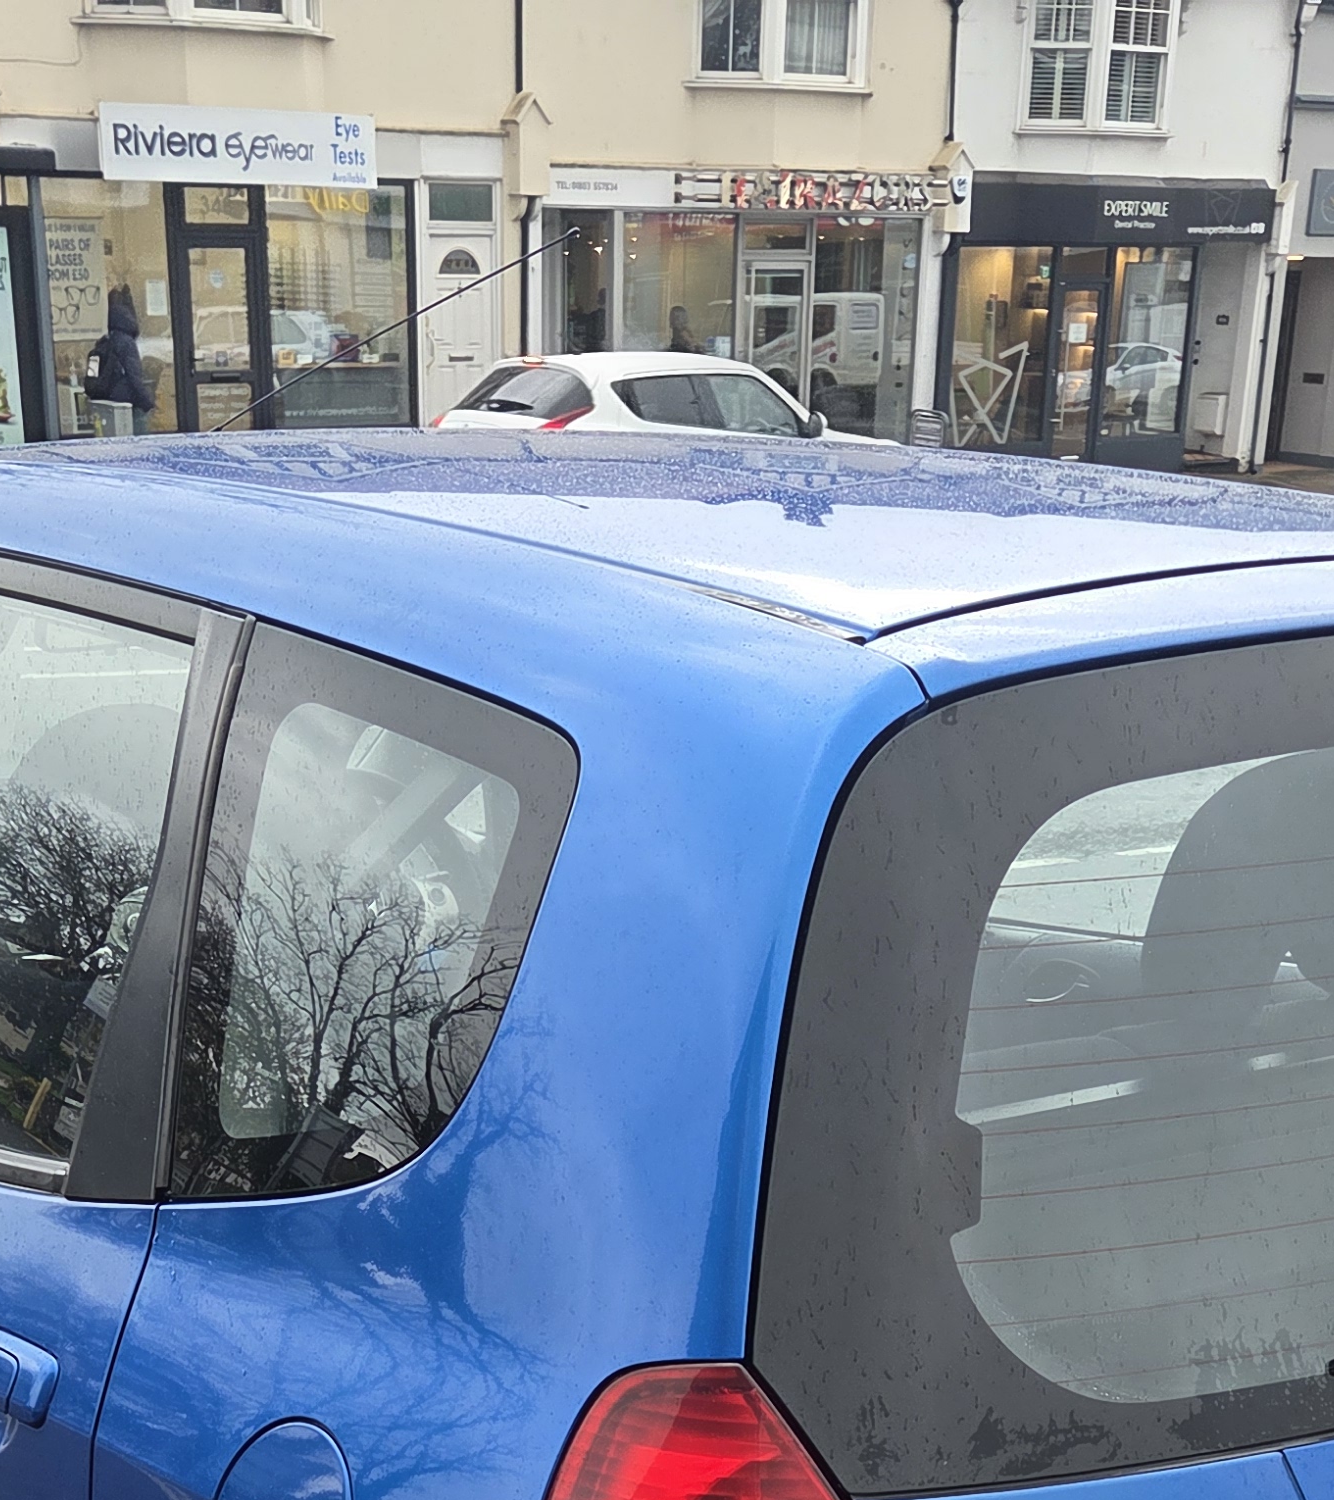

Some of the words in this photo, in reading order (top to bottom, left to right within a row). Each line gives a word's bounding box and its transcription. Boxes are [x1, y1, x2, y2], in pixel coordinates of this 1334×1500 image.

[334, 116, 360, 142] Eye
[112, 123, 217, 158] Riviera
[225, 131, 314, 171] eyewear
[330, 144, 366, 166] Tests
[332, 172, 367, 184] Available
[1104, 200, 1139, 216] EXPERT
[1140, 200, 1170, 217] SMILE
[48, 238, 77, 251] PAIRS
[78, 238, 91, 251] OF
